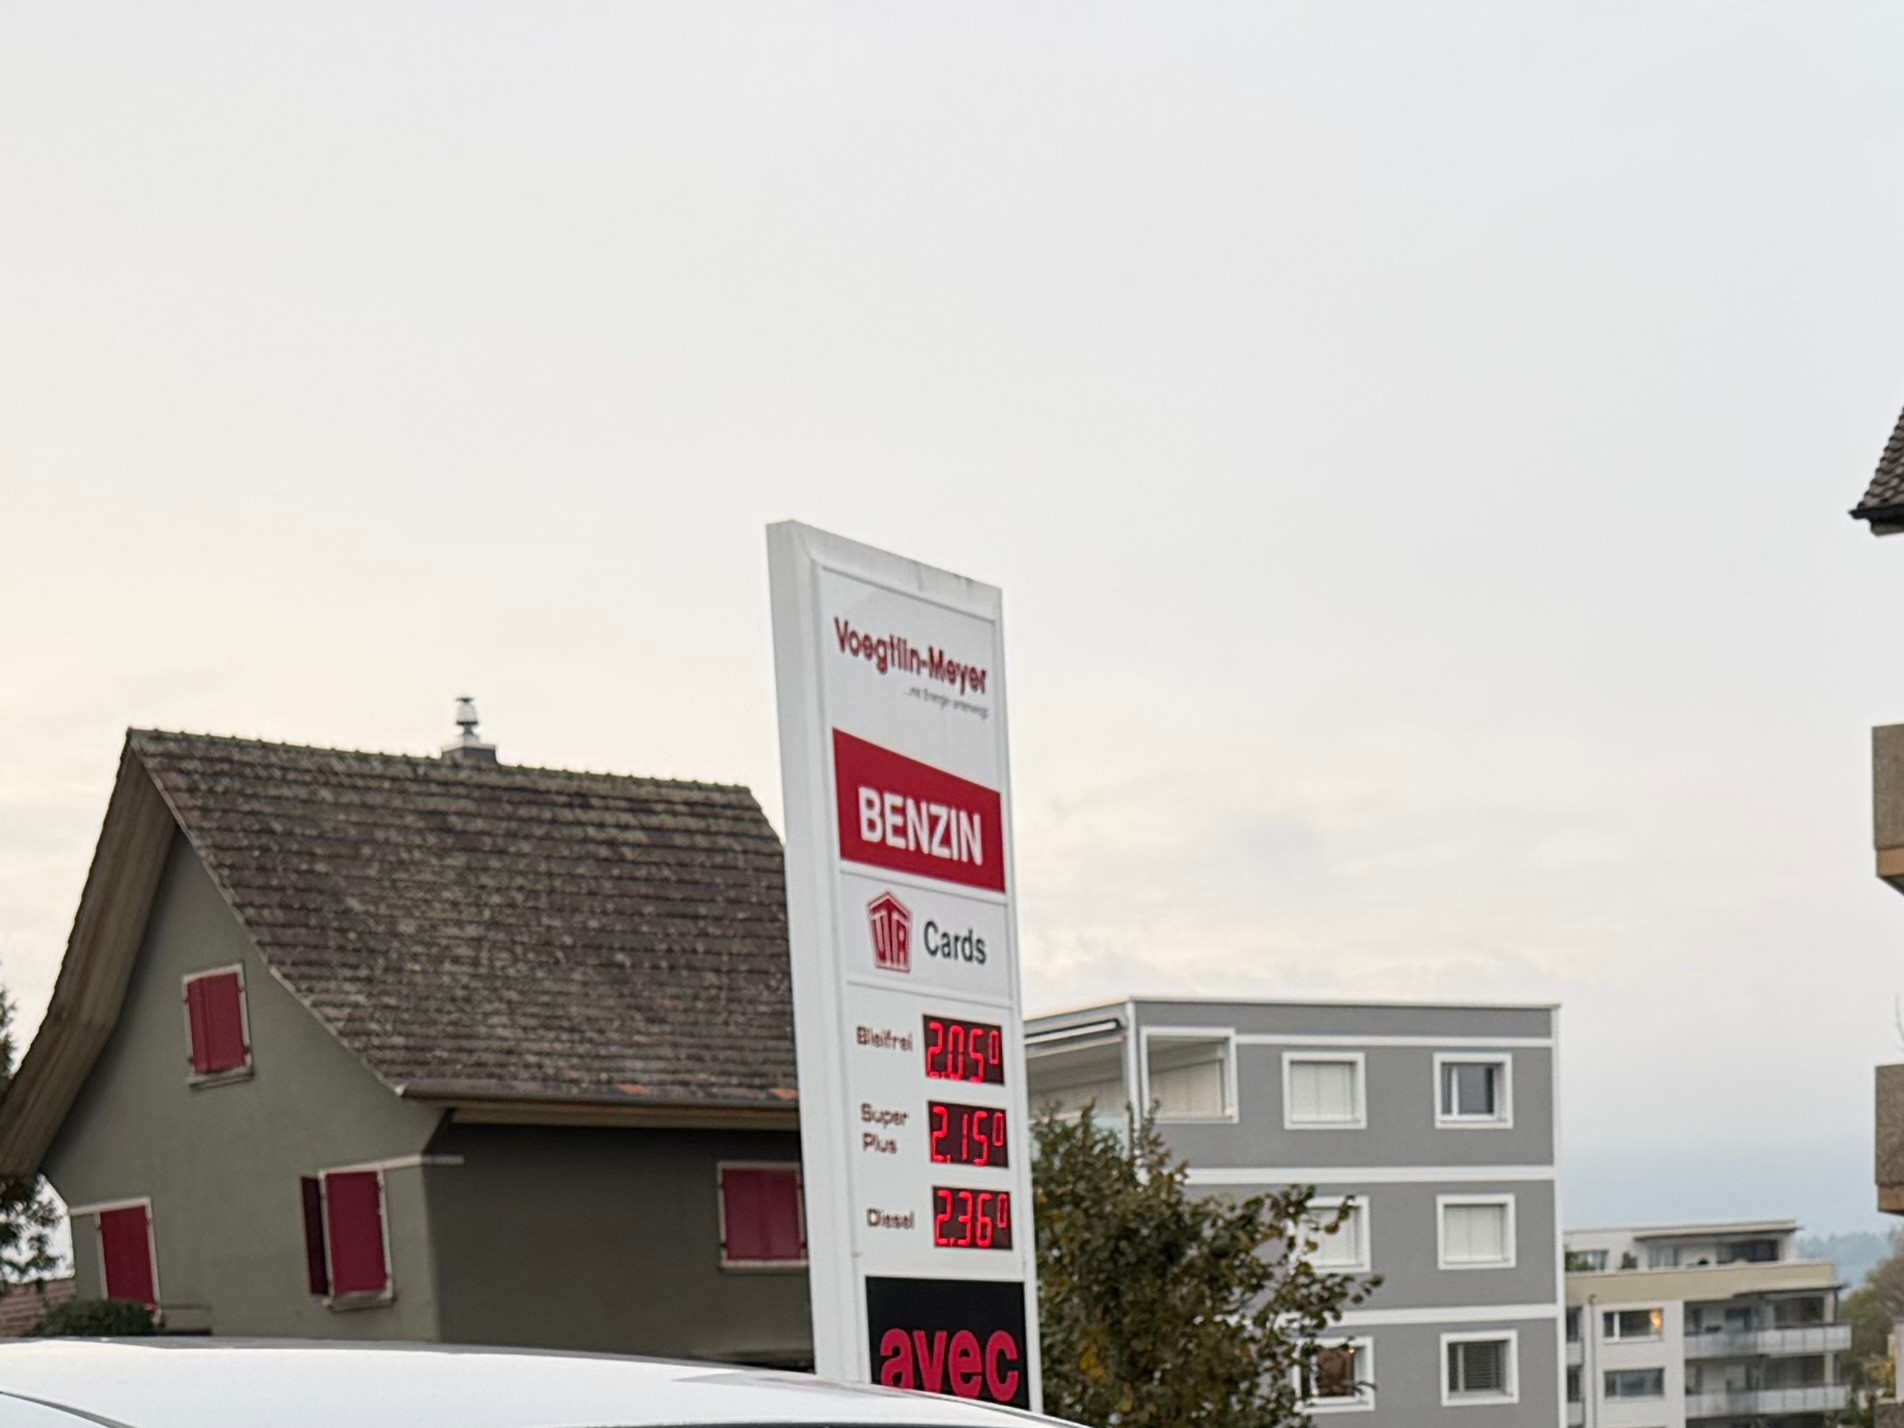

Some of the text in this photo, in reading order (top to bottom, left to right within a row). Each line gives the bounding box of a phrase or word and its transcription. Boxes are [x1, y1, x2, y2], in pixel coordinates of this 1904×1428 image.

[833, 616, 987, 696] Voegtlin-Meyer
[857, 785, 984, 867] BENZIN
[923, 919, 988, 966] Cards
[856, 1025, 913, 1052] Bleifrei
[860, 1102, 908, 1129] Super
[862, 1132, 898, 1154] Plus
[866, 1207, 915, 1230] Diesel
[879, 1327, 1020, 1403] avec
